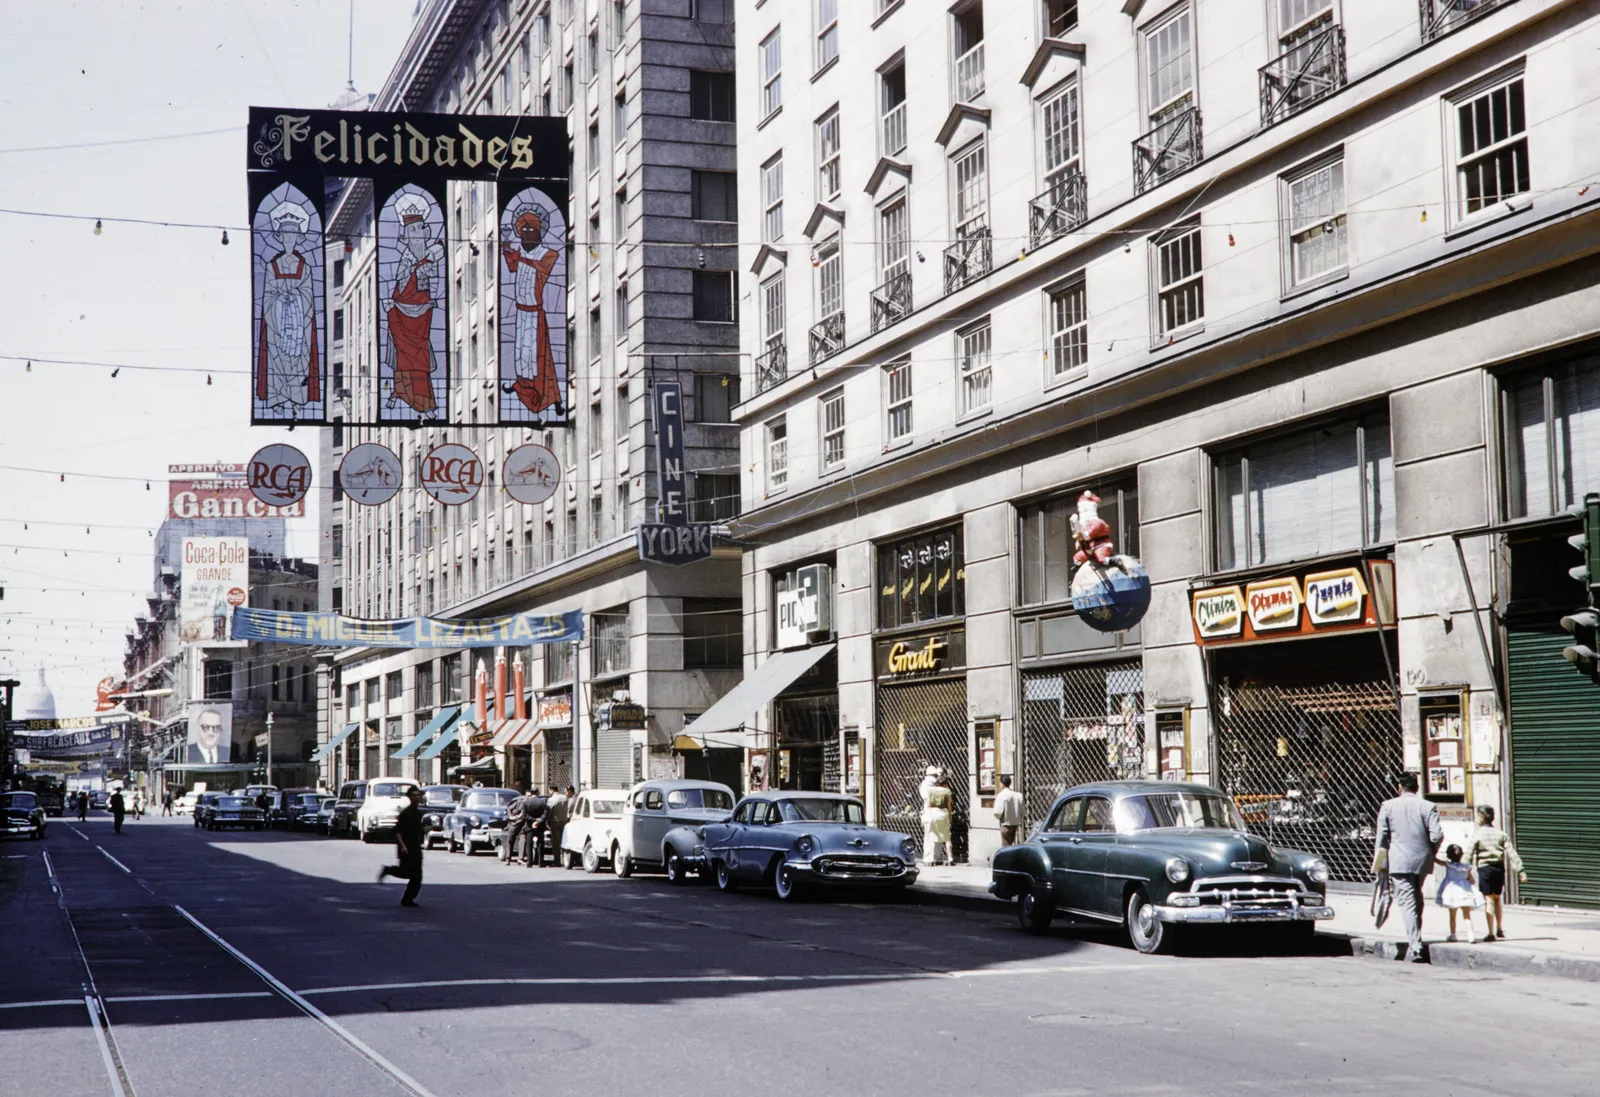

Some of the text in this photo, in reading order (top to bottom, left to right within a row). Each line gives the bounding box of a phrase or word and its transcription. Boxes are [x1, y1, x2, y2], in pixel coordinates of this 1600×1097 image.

[254, 113, 534, 171] Felicidades
[661, 391, 683, 516] CINE
[170, 463, 235, 473] APERITIVO
[249, 461, 308, 498] RCA
[423, 456, 482, 494] RCA
[190, 480, 249, 490] AMERIC
[173, 491, 301, 518] Gancia
[186, 541, 245, 564] Coca-Cola
[642, 526, 709, 557] YORK
[196, 567, 232, 581] GRANDE
[780, 583, 818, 631] PICNIC
[1250, 591, 1293, 617] Plumas
[305, 615, 400, 642] MIGUEL
[415, 613, 533, 643] LEZAETA
[543, 614, 565, 637] 15
[889, 637, 943, 673] Grant
[26, 719, 53, 730] JOSE
[55, 717, 97, 729] MARCOS
[26, 730, 91, 750] SUBERCASEAUX
[110, 725, 120, 739] 16
